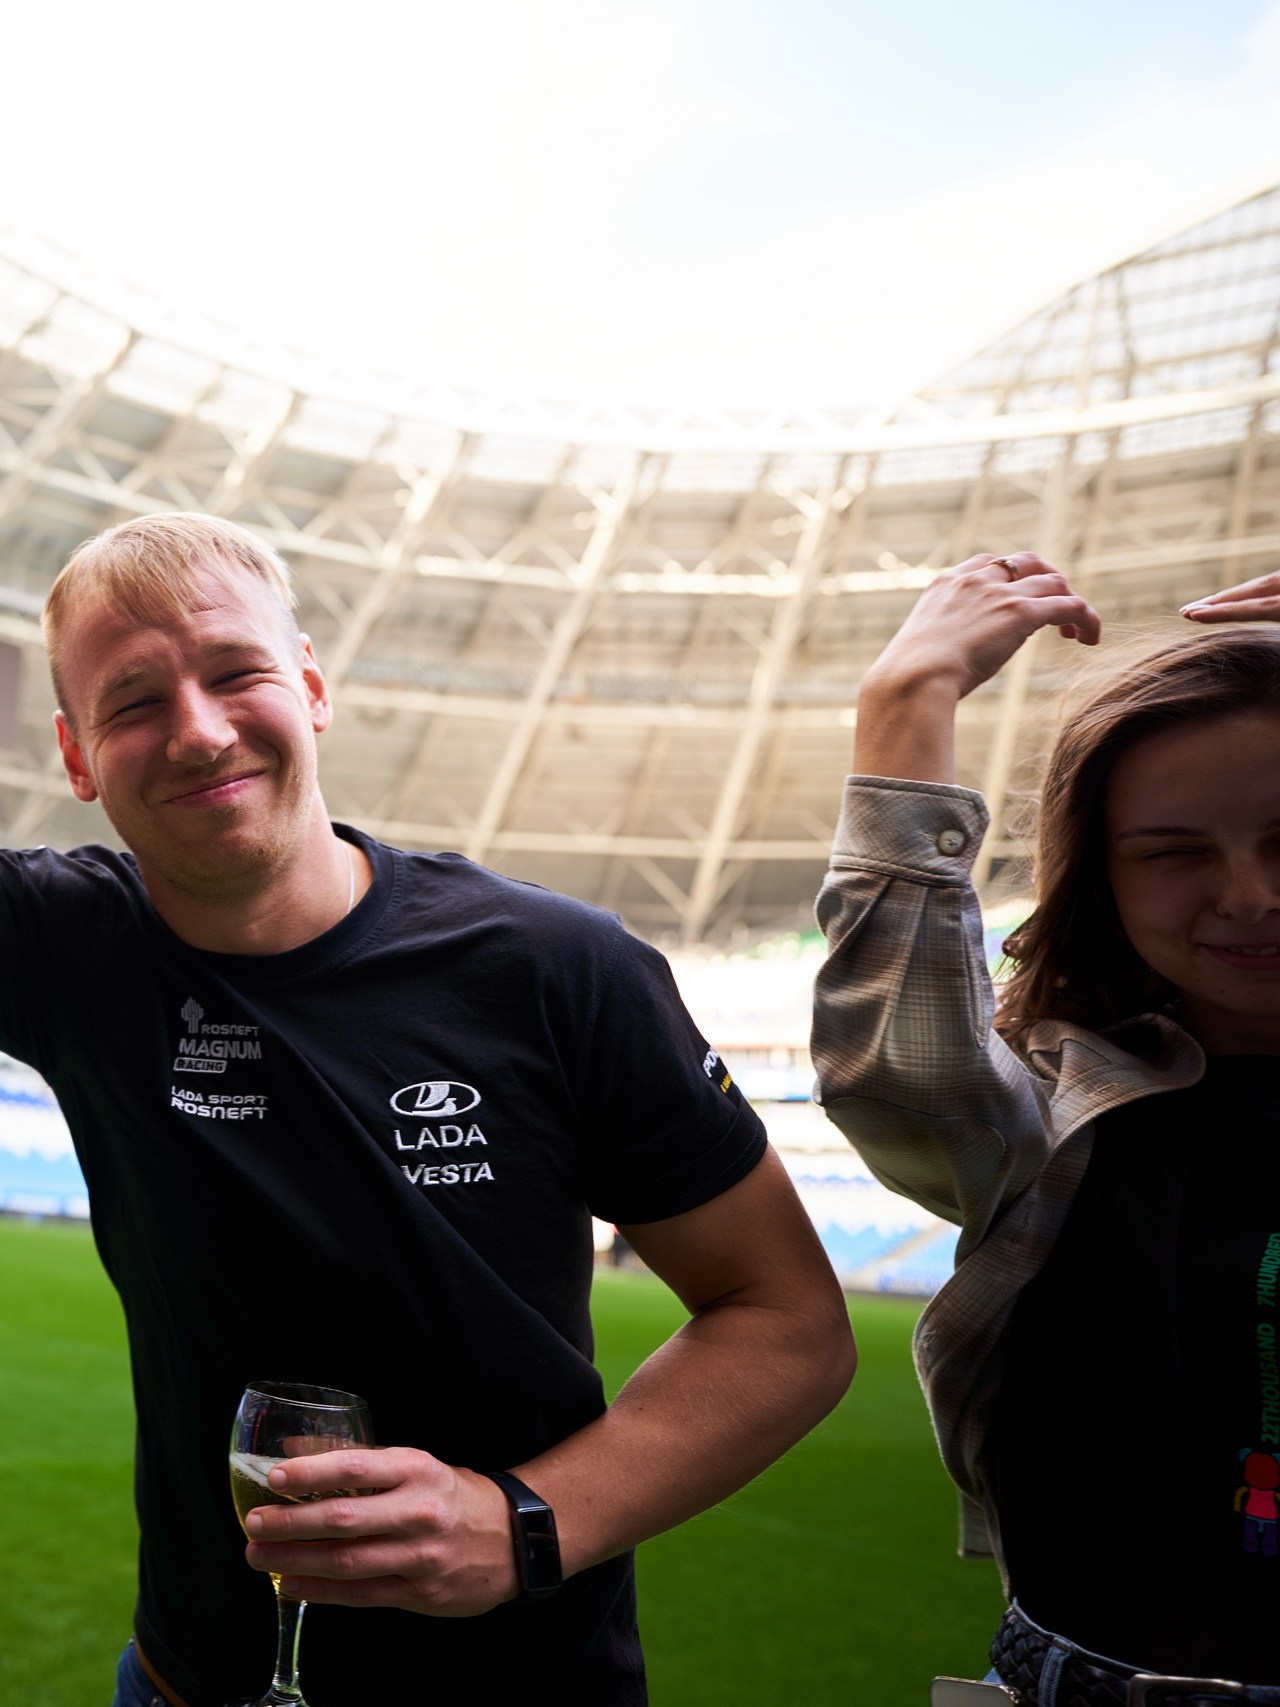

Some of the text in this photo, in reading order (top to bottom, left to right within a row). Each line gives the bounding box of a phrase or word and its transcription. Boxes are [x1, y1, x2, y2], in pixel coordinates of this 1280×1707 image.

[200, 1024, 260, 1037] ROSNEFT
[178, 1037, 263, 1060] MAGNUM
[176, 1059, 224, 1071] RACING
[171, 1085, 269, 1105] LADA SPORT
[170, 1097, 269, 1120] ROSNEFT
[393, 1123, 488, 1151] LADA
[401, 1162, 495, 1186] VESTA
[1256, 1322, 1280, 1446] 22THOUSAND
